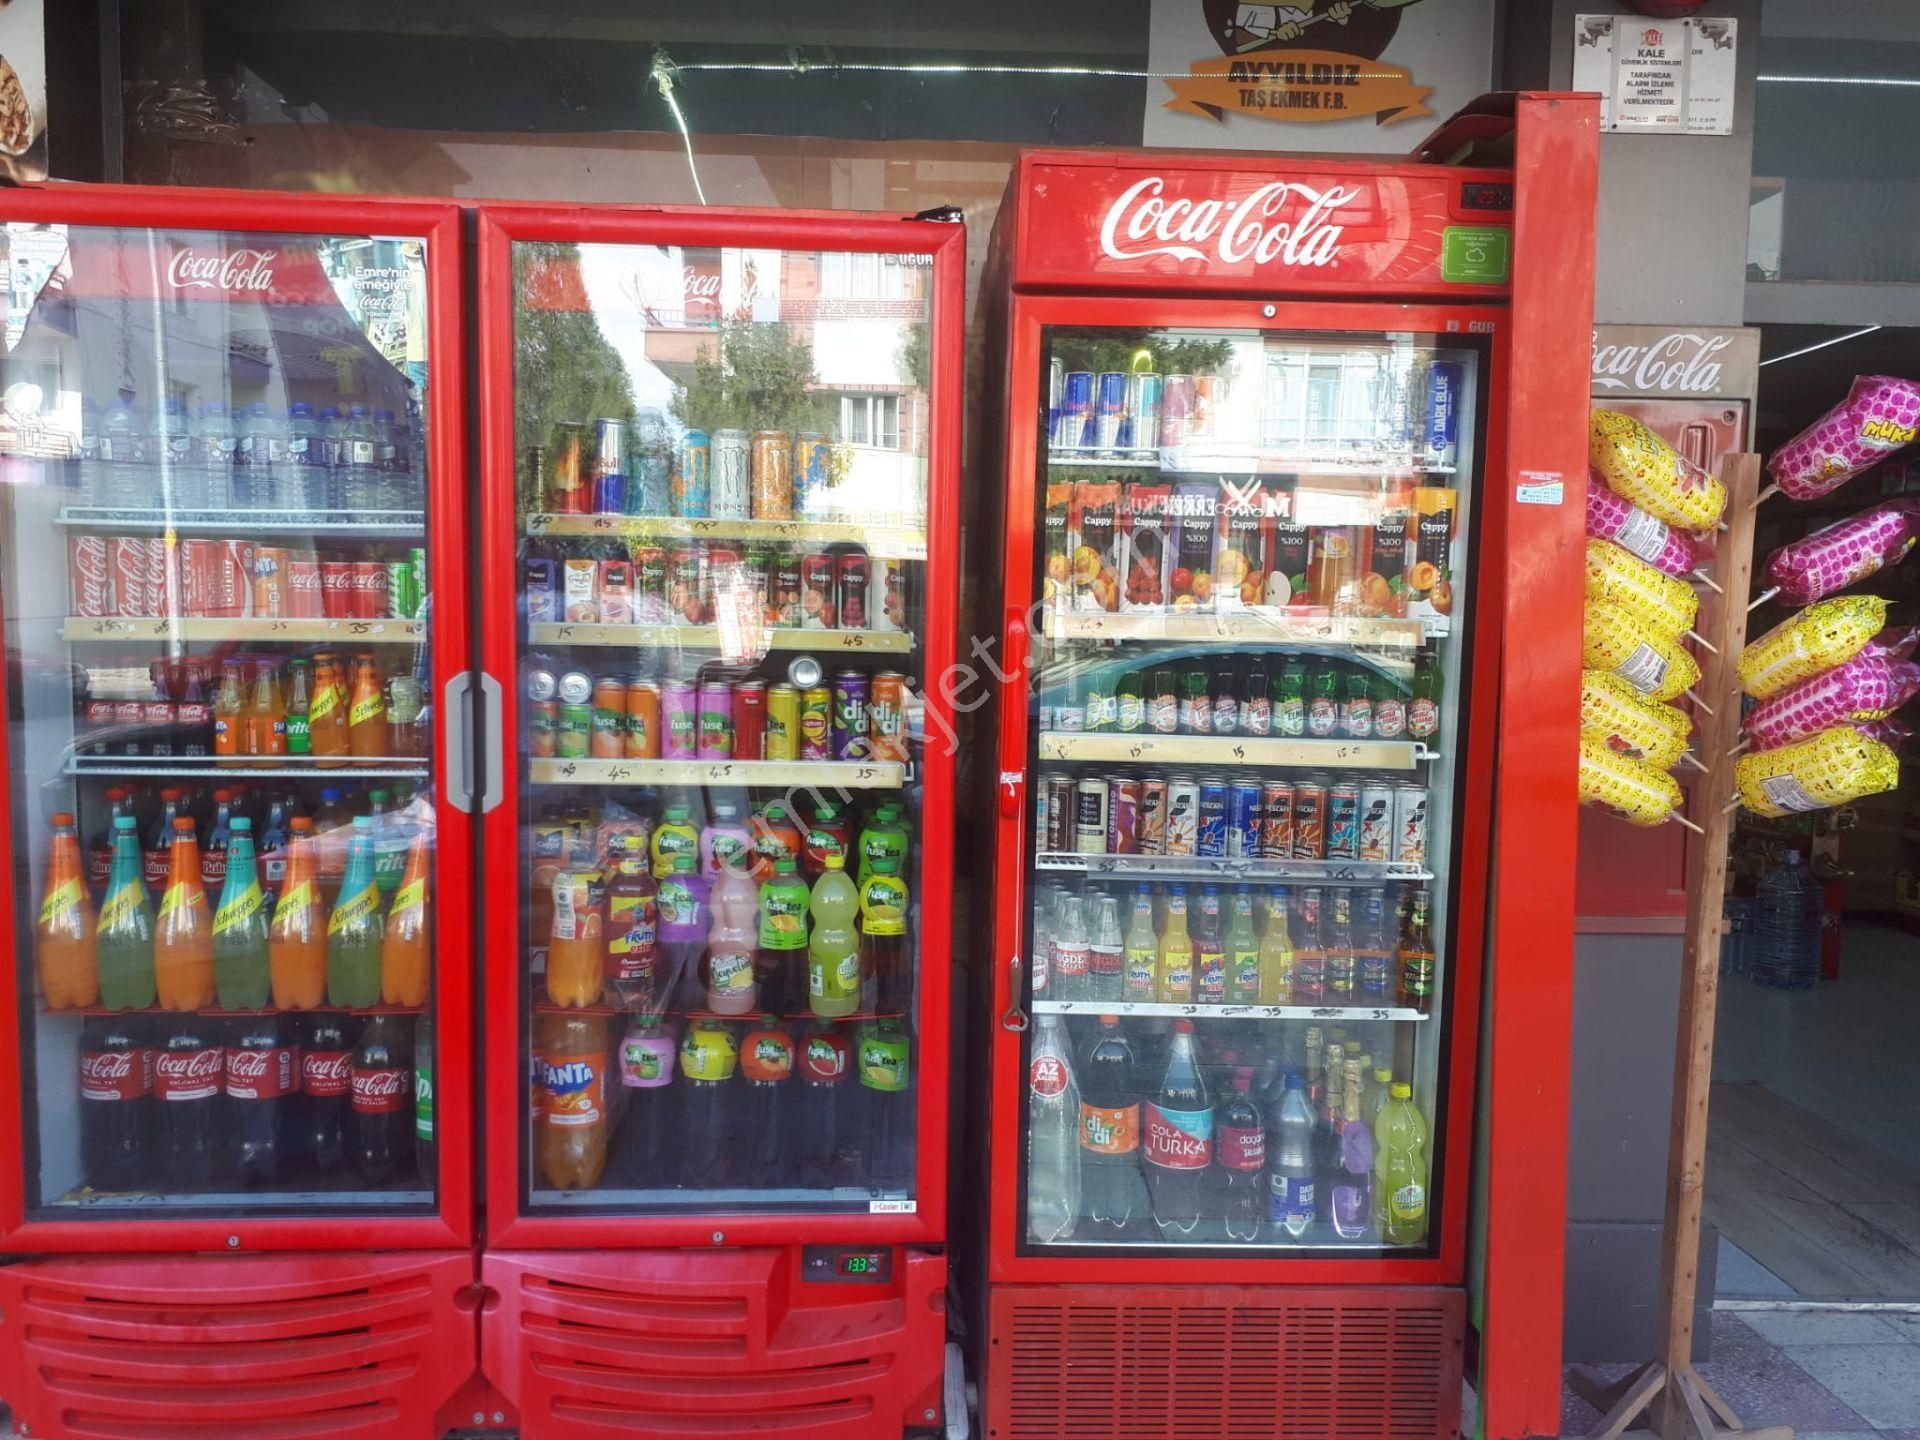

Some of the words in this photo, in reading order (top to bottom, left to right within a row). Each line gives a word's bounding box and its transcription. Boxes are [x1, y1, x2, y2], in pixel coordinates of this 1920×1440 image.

[1637, 49, 1665, 58] KALE
[1227, 61, 1361, 87] AYYILDIZ
[1240, 89, 1266, 110] TAŞ
[1270, 89, 1320, 109] EKMEK
[1323, 91, 1348, 109] F.B.
[1100, 177, 1360, 268] Coca-Cola
[168, 247, 277, 291] Coca-Cola
[1591, 333, 1735, 393] ca-Cola
[1436, 375, 1448, 402] BLUE
[1434, 402, 1446, 432] DARK
[1084, 515, 1111, 526] Cappy
[1134, 516, 1161, 528] Cappy
[1184, 518, 1211, 530] Cappy
[1232, 520, 1259, 531] Cappy
[1279, 522, 1306, 533] Cappy
[1376, 523, 1404, 534] Cappy
[1421, 521, 1448, 533] Cappy
[254, 557, 279, 574] NTA
[349, 622, 372, 634] 35
[843, 634, 864, 646] 45
[1233, 746, 1245, 758] 15
[856, 768, 876, 779] 35
[866, 846, 900, 857] fusetea
[766, 901, 801, 912] fusetea
[156, 1049, 223, 1077] Coca-Cola
[303, 1053, 351, 1078] Coca-Co
[543, 1063, 594, 1086] FANTA
[1151, 1124, 1182, 1139] COLA
[1151, 1135, 1206, 1157] TURKA
